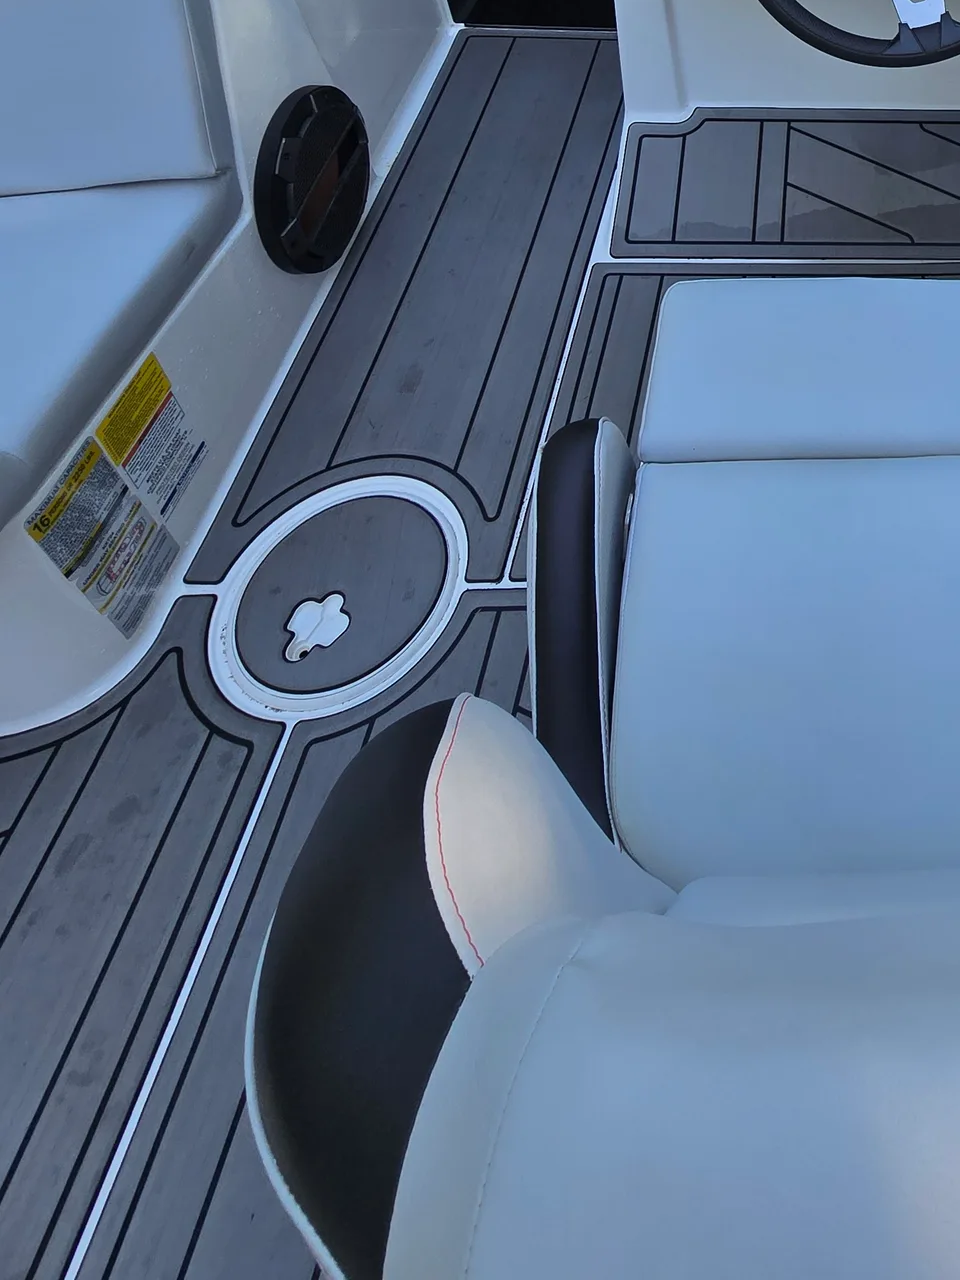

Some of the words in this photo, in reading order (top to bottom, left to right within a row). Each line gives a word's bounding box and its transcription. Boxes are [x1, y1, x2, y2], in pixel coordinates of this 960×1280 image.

[26, 484, 60, 526] MAXIMUM
[58, 439, 91, 486] CAPACITIES
[30, 511, 51, 533] 16
